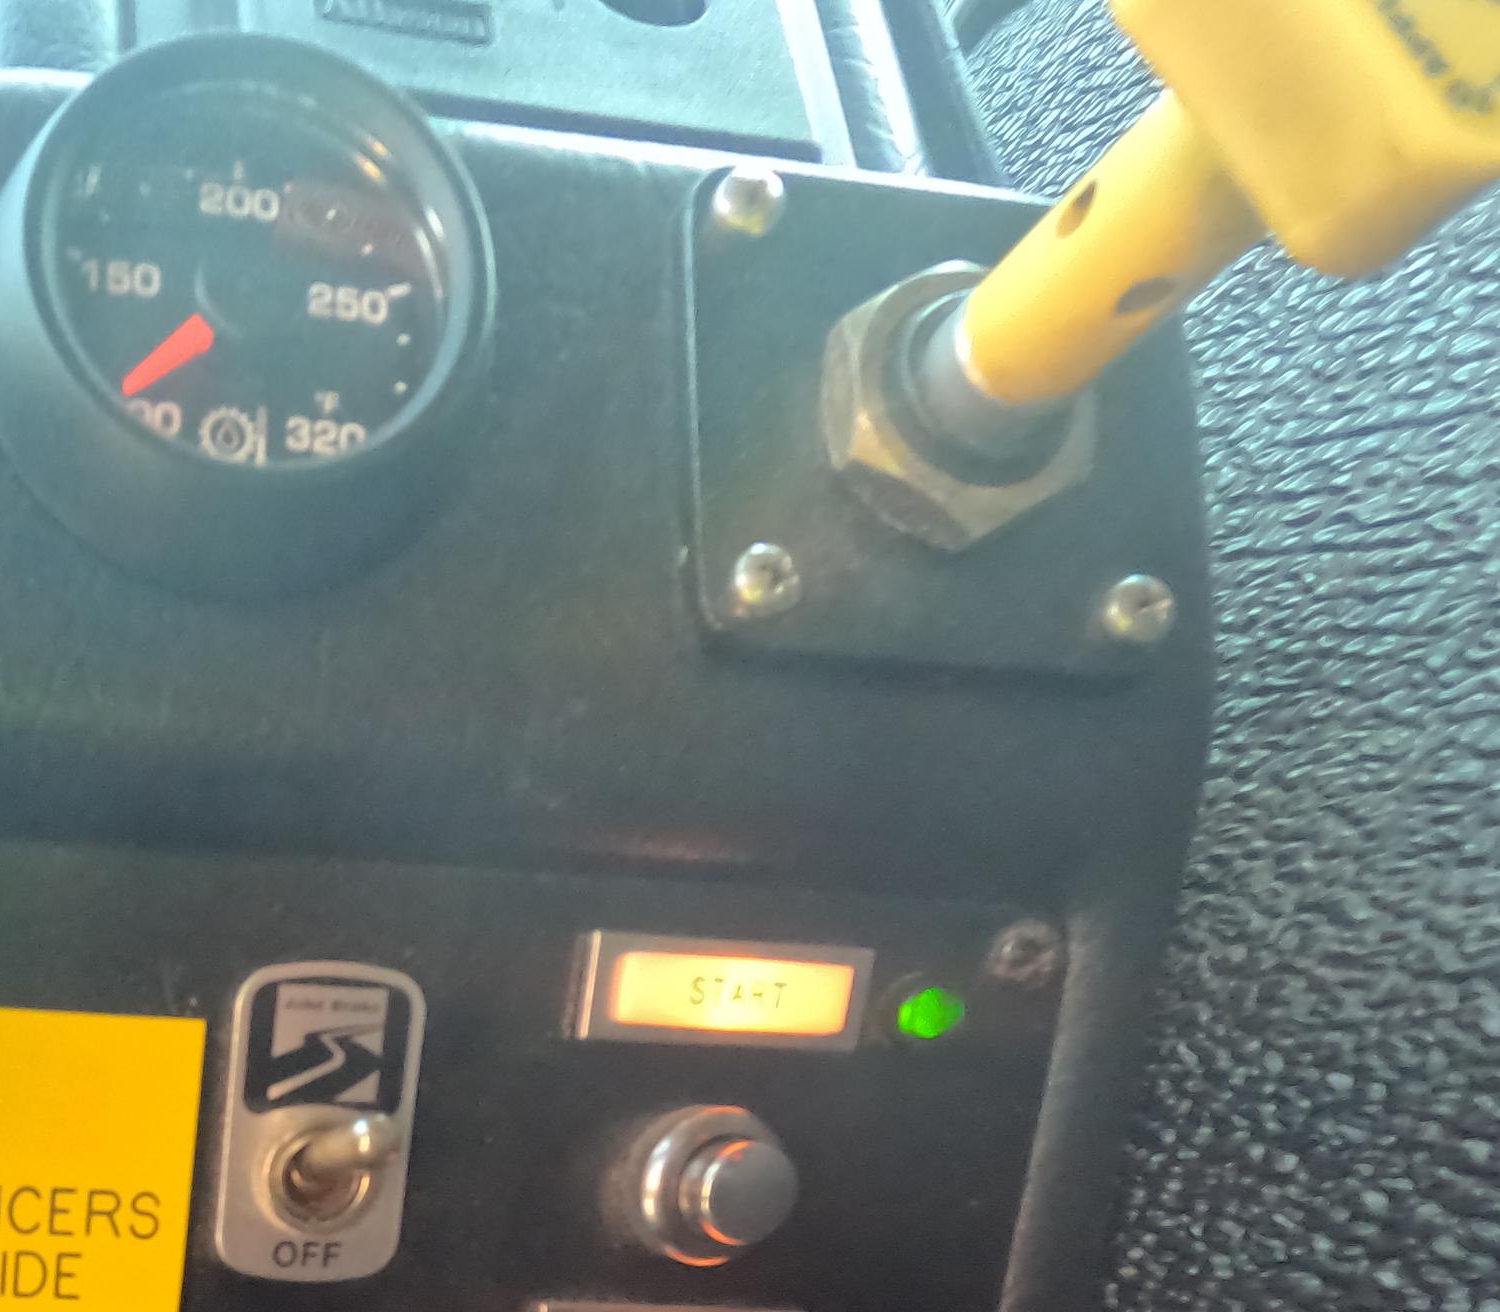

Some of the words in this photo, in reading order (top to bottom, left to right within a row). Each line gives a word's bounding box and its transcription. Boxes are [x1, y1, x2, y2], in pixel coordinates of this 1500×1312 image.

[198, 181, 281, 222] 200
[81, 259, 161, 297] 150
[306, 281, 389, 325] 250
[284, 415, 367, 456] 320
[272, 1241, 342, 1268] OFF
